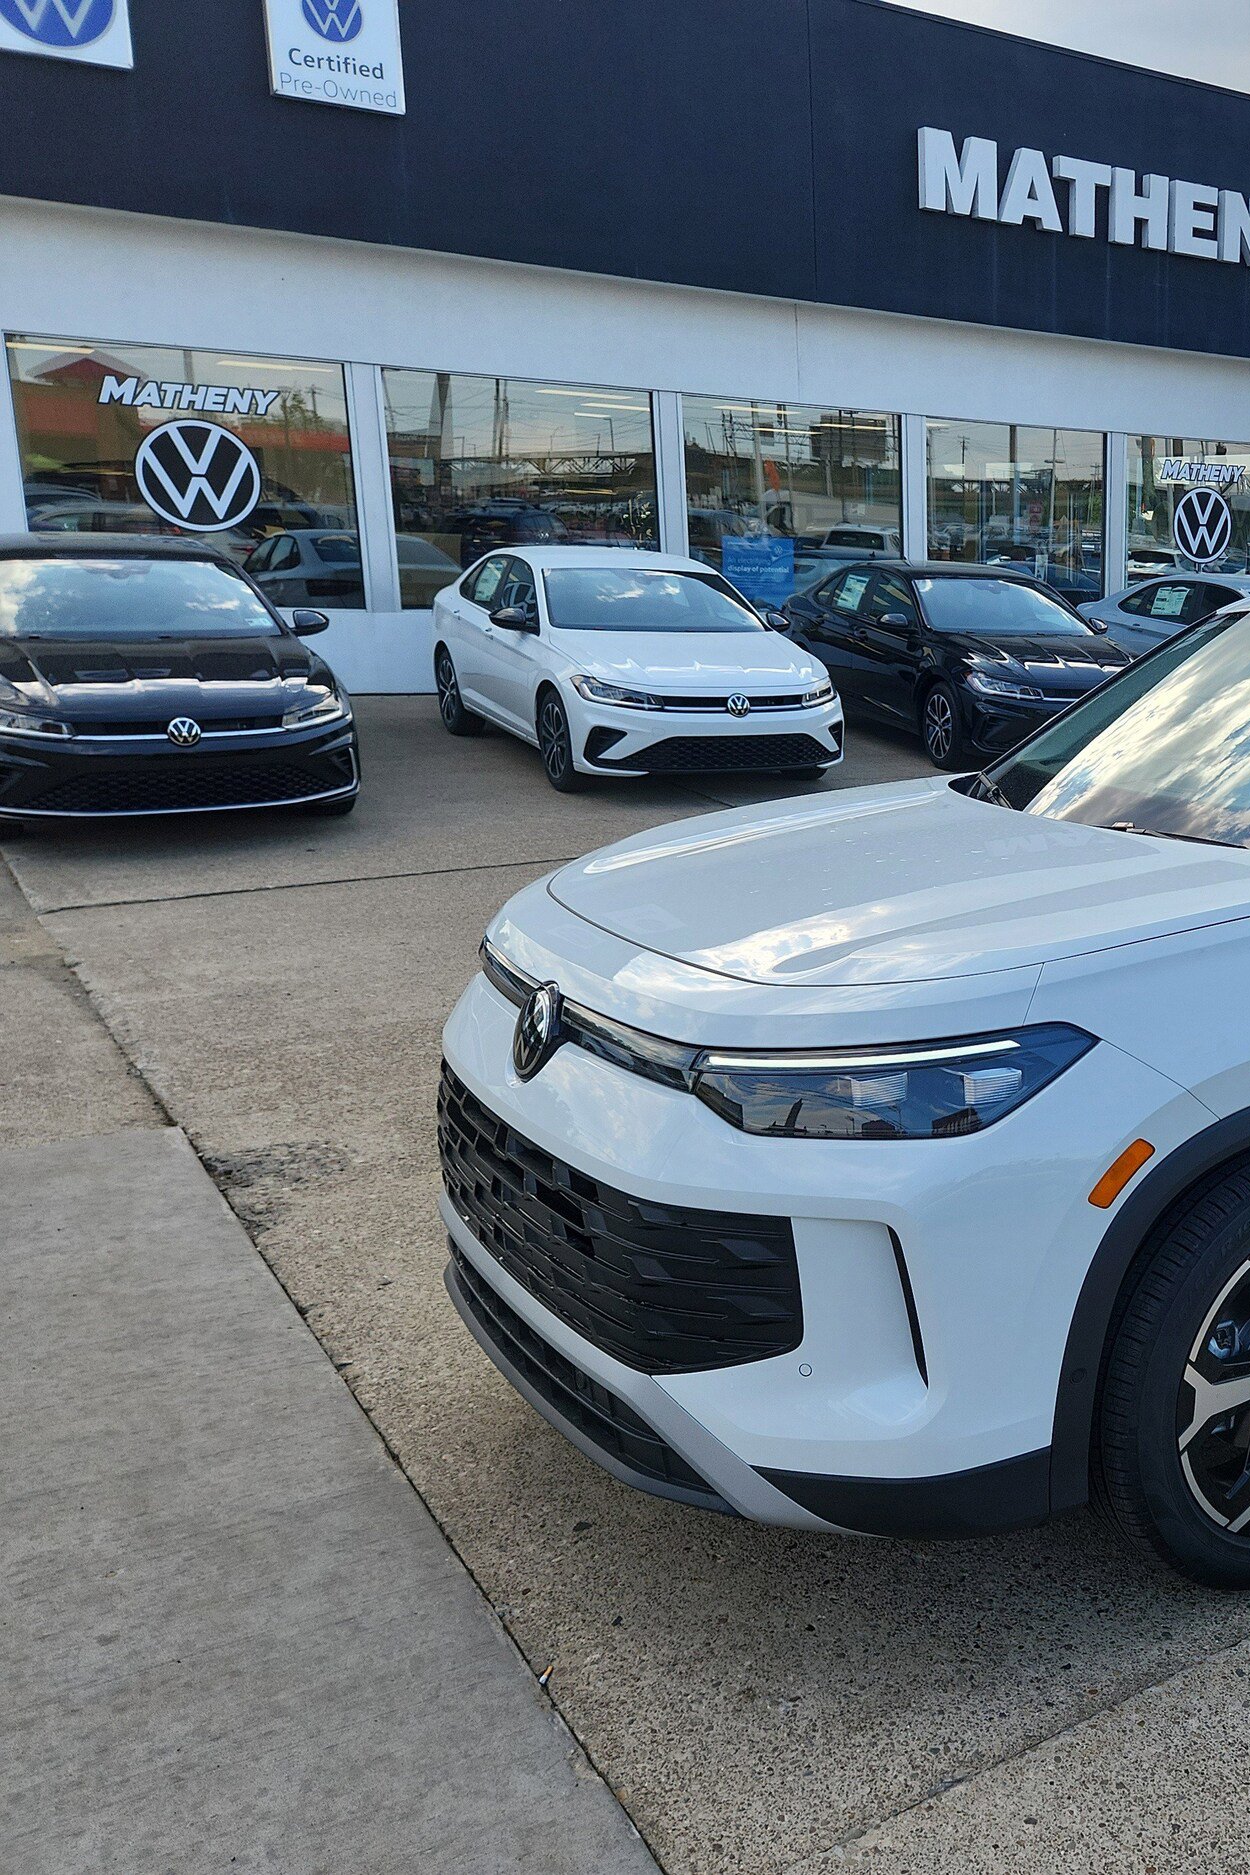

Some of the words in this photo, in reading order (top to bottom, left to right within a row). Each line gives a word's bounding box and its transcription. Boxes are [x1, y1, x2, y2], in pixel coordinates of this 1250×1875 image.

[288, 47, 384, 80] Certified
[279, 71, 397, 108] Pre-Owned
[98, 374, 280, 415] MATHENY
[1161, 459, 1245, 483] MATHENY
[728, 565, 751, 573] display
